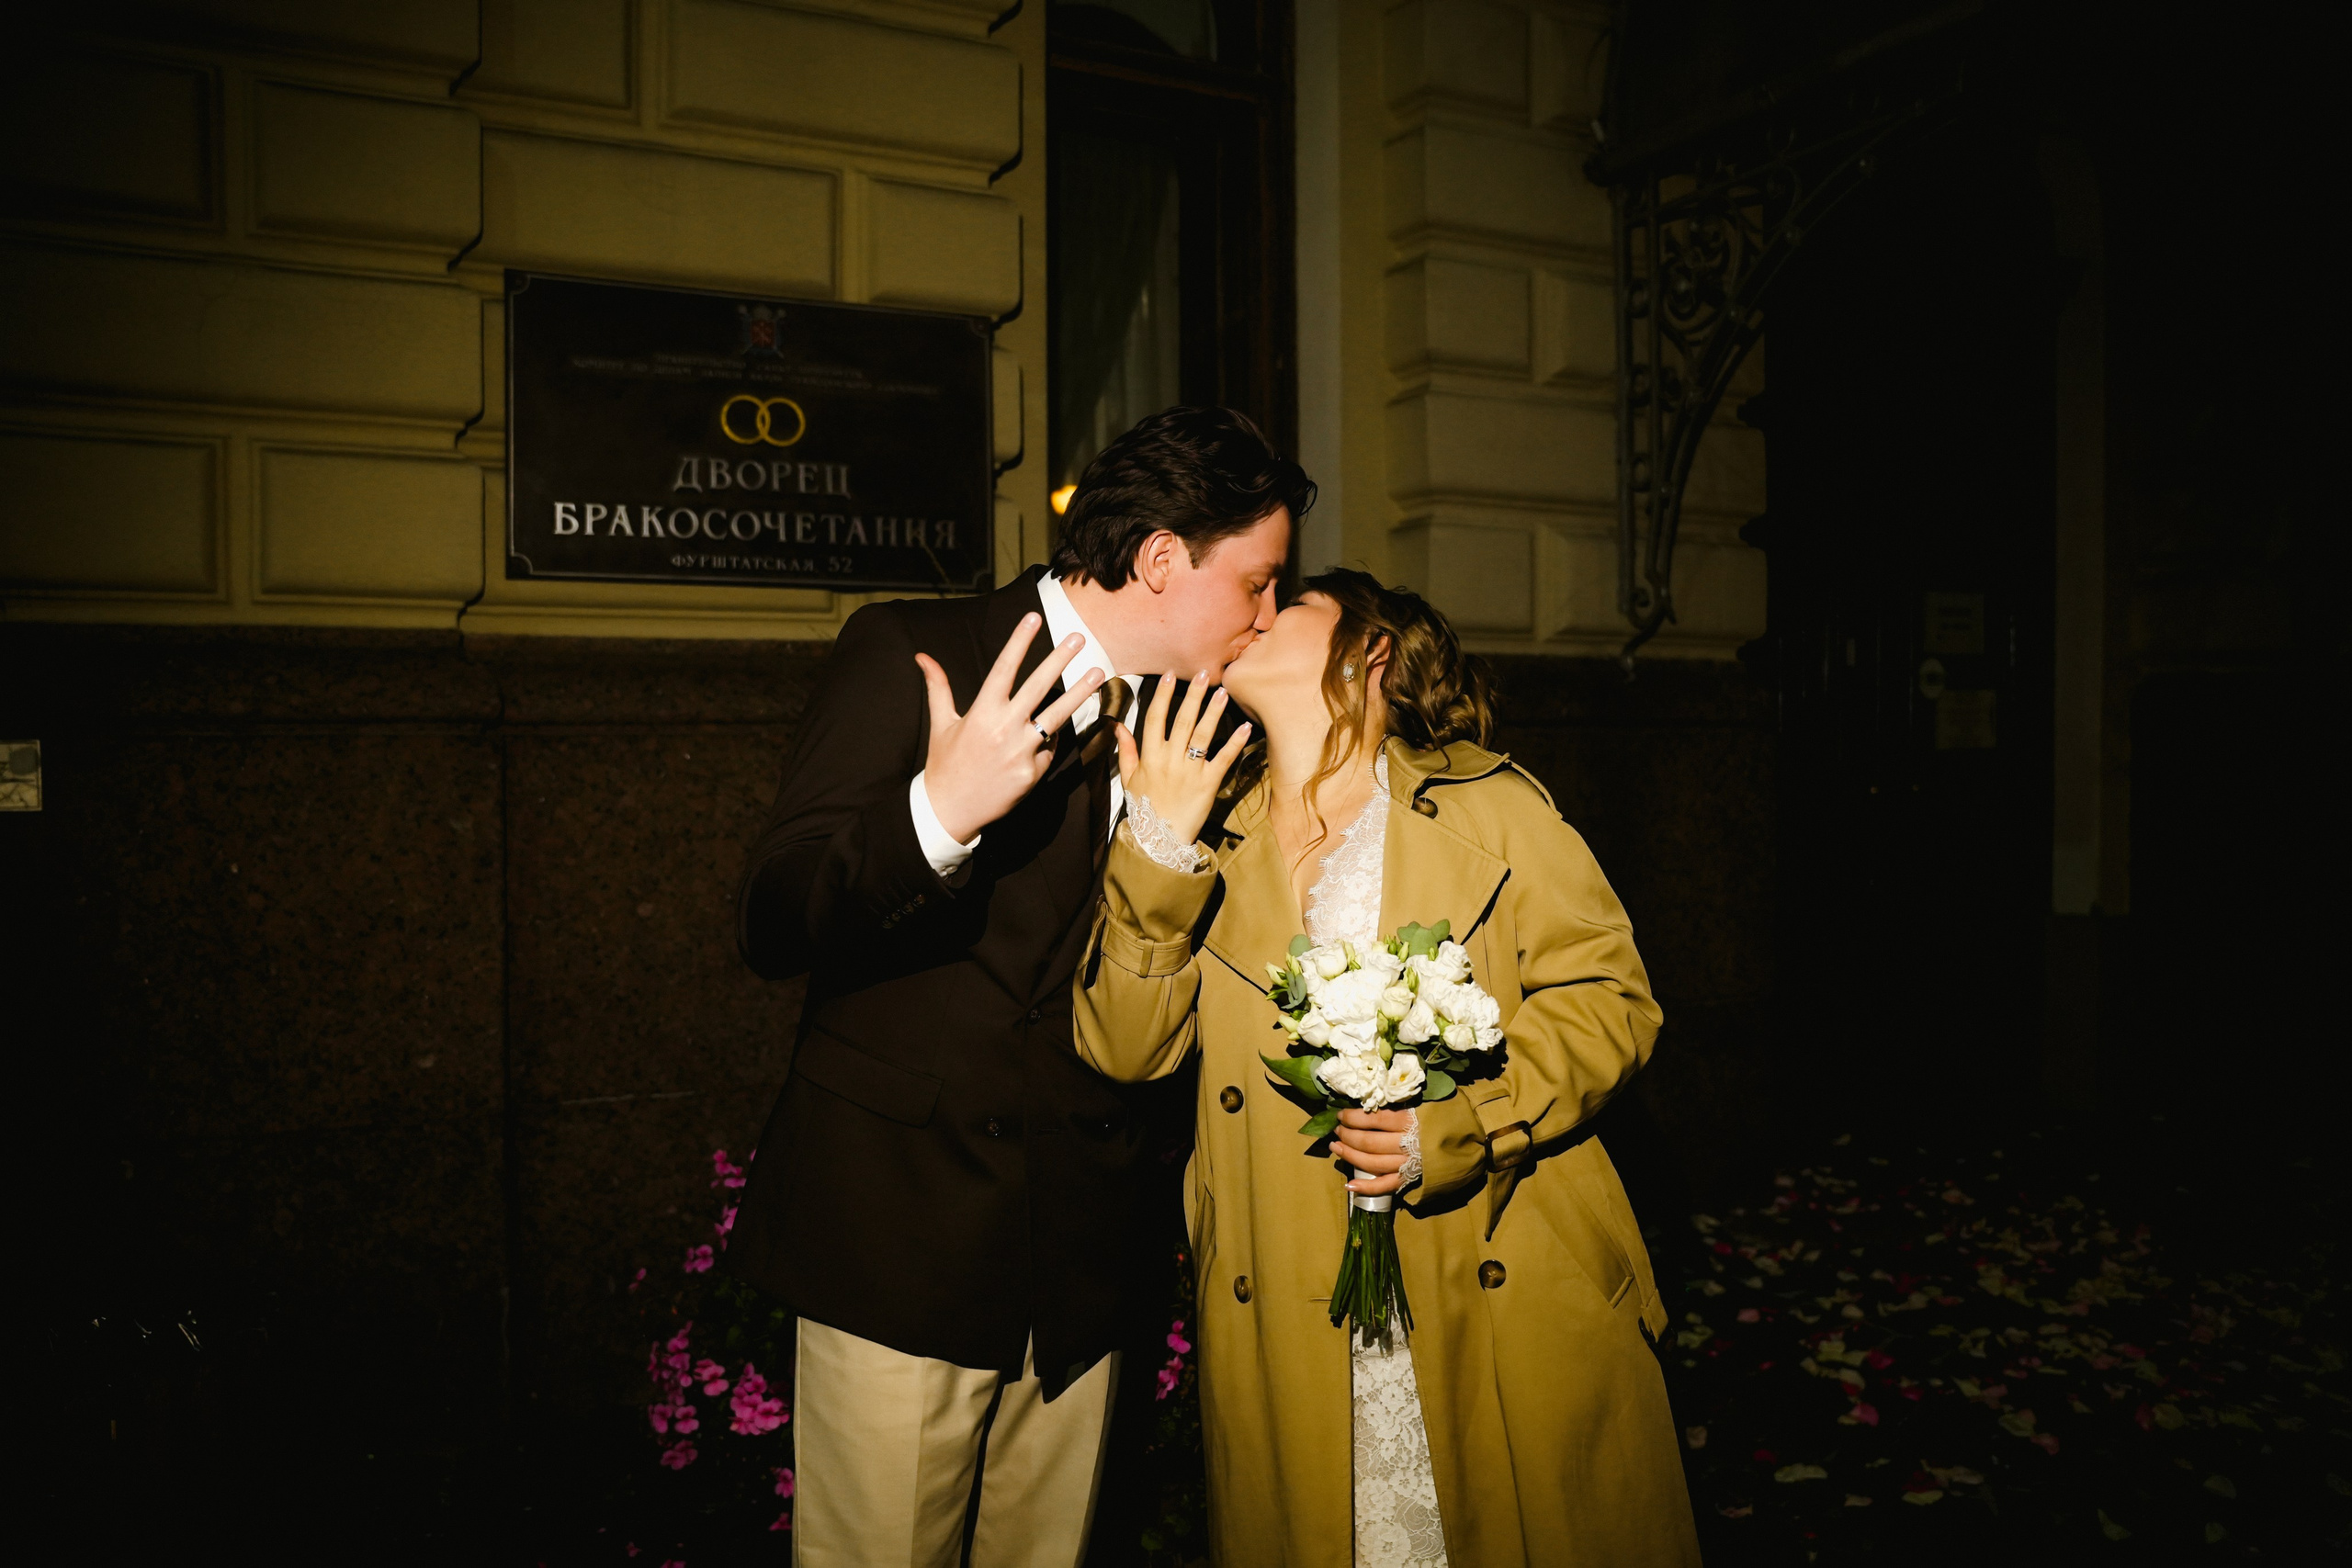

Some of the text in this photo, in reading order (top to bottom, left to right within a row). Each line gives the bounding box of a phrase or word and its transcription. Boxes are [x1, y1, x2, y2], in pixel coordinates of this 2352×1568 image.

[672, 457, 851, 500] ДВОРЕЦ
[553, 501, 957, 550] БРАКОСОЧЕТАНИЯ
[828, 555, 854, 574] 52
